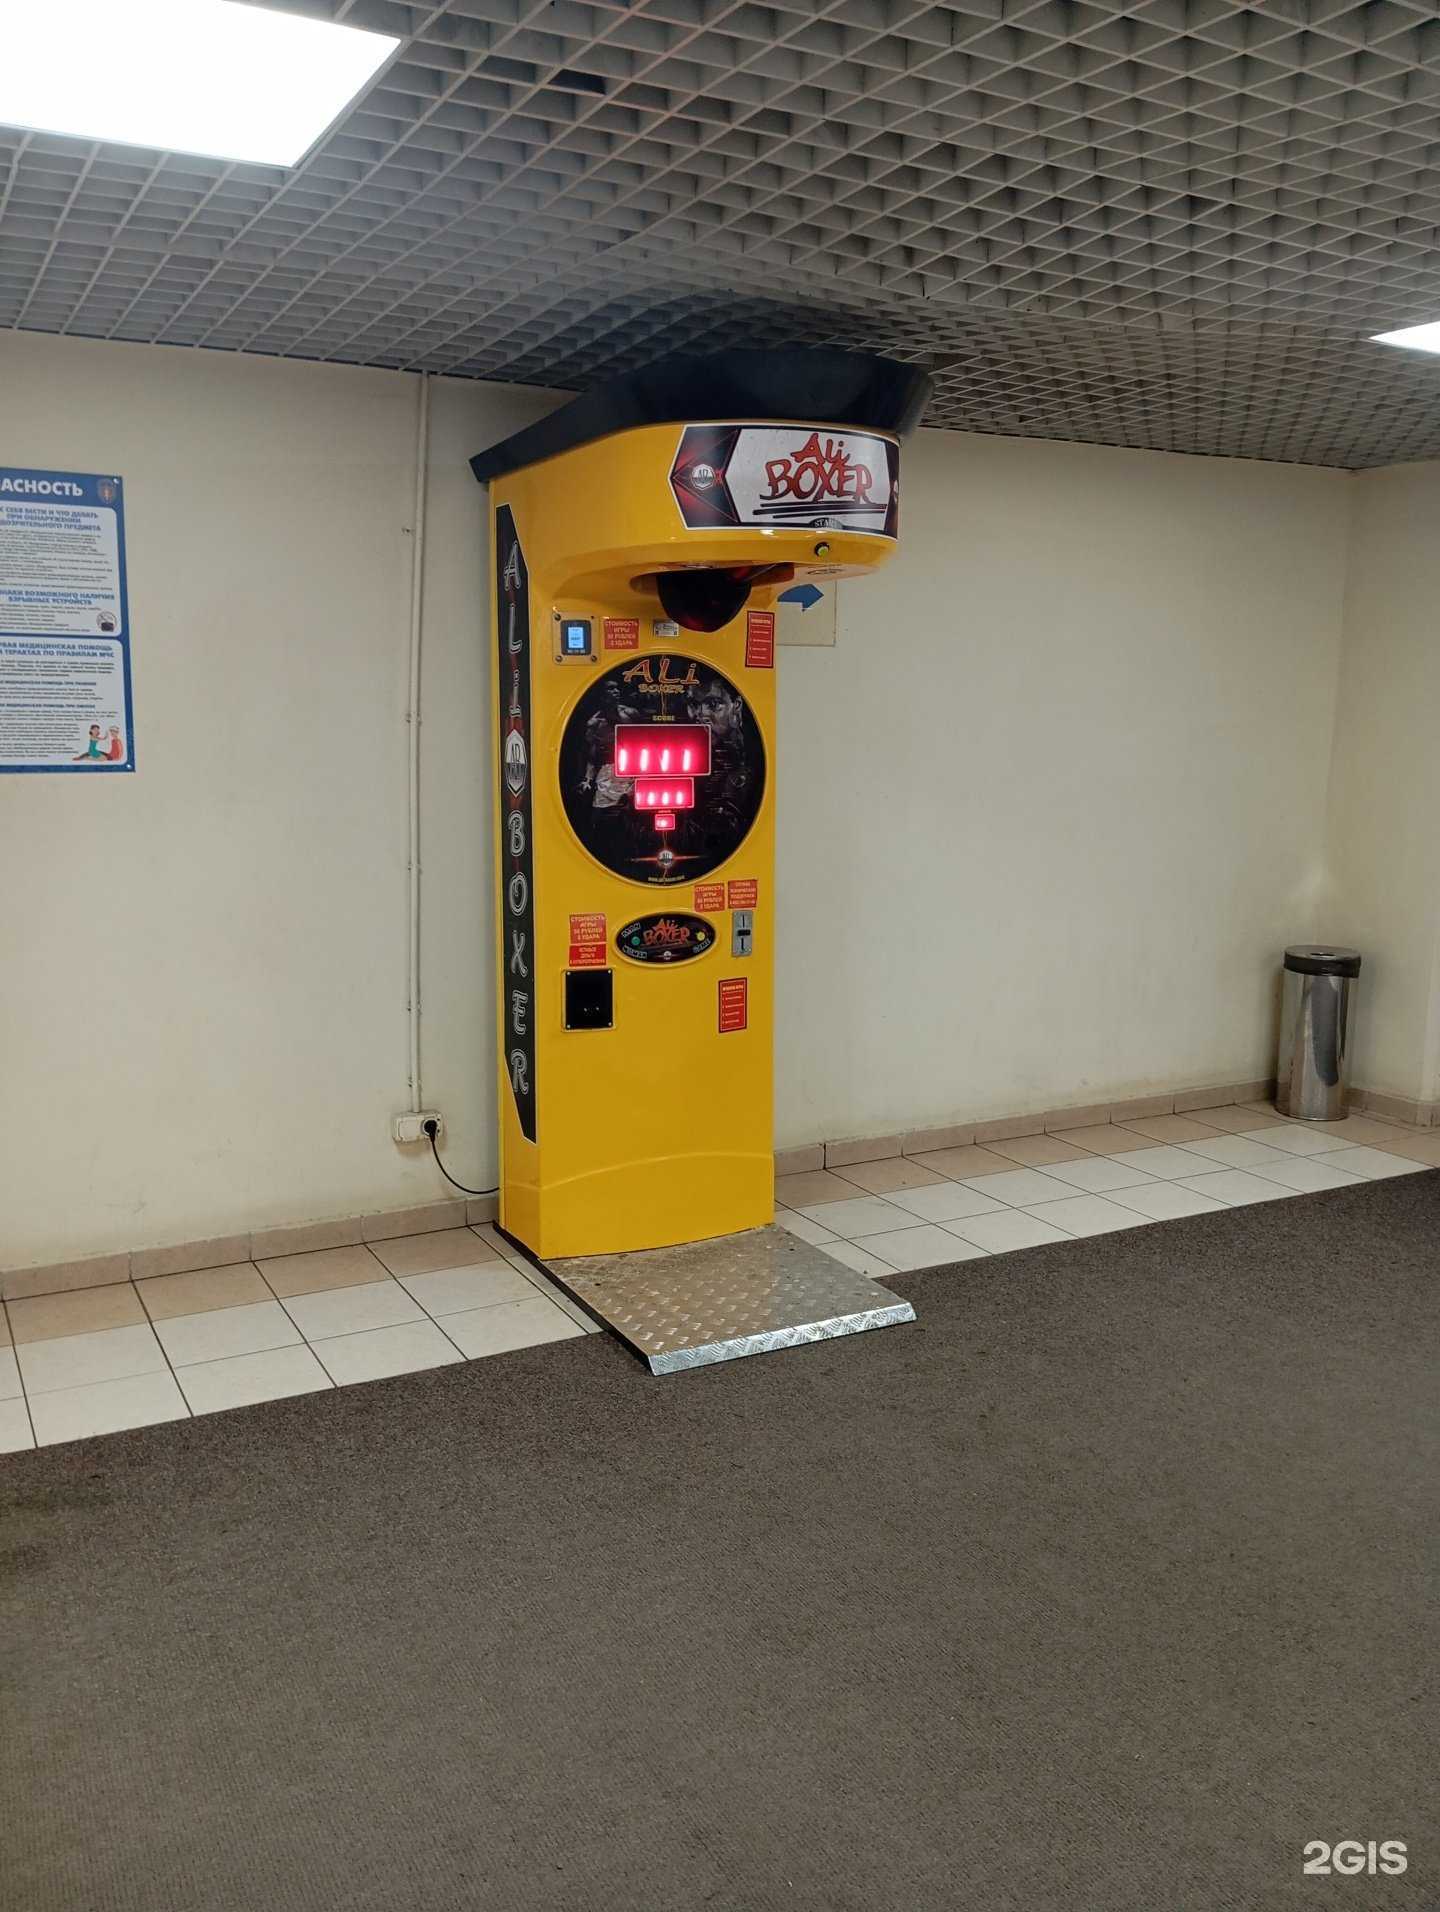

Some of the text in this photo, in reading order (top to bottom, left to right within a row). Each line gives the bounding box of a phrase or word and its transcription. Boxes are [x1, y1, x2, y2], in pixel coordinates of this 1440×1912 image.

[790, 432, 850, 465] Ali
[0, 478, 84, 497] АСНОСТЬ
[760, 457, 874, 504] BOXER
[643, 927, 690, 945] BOXER
